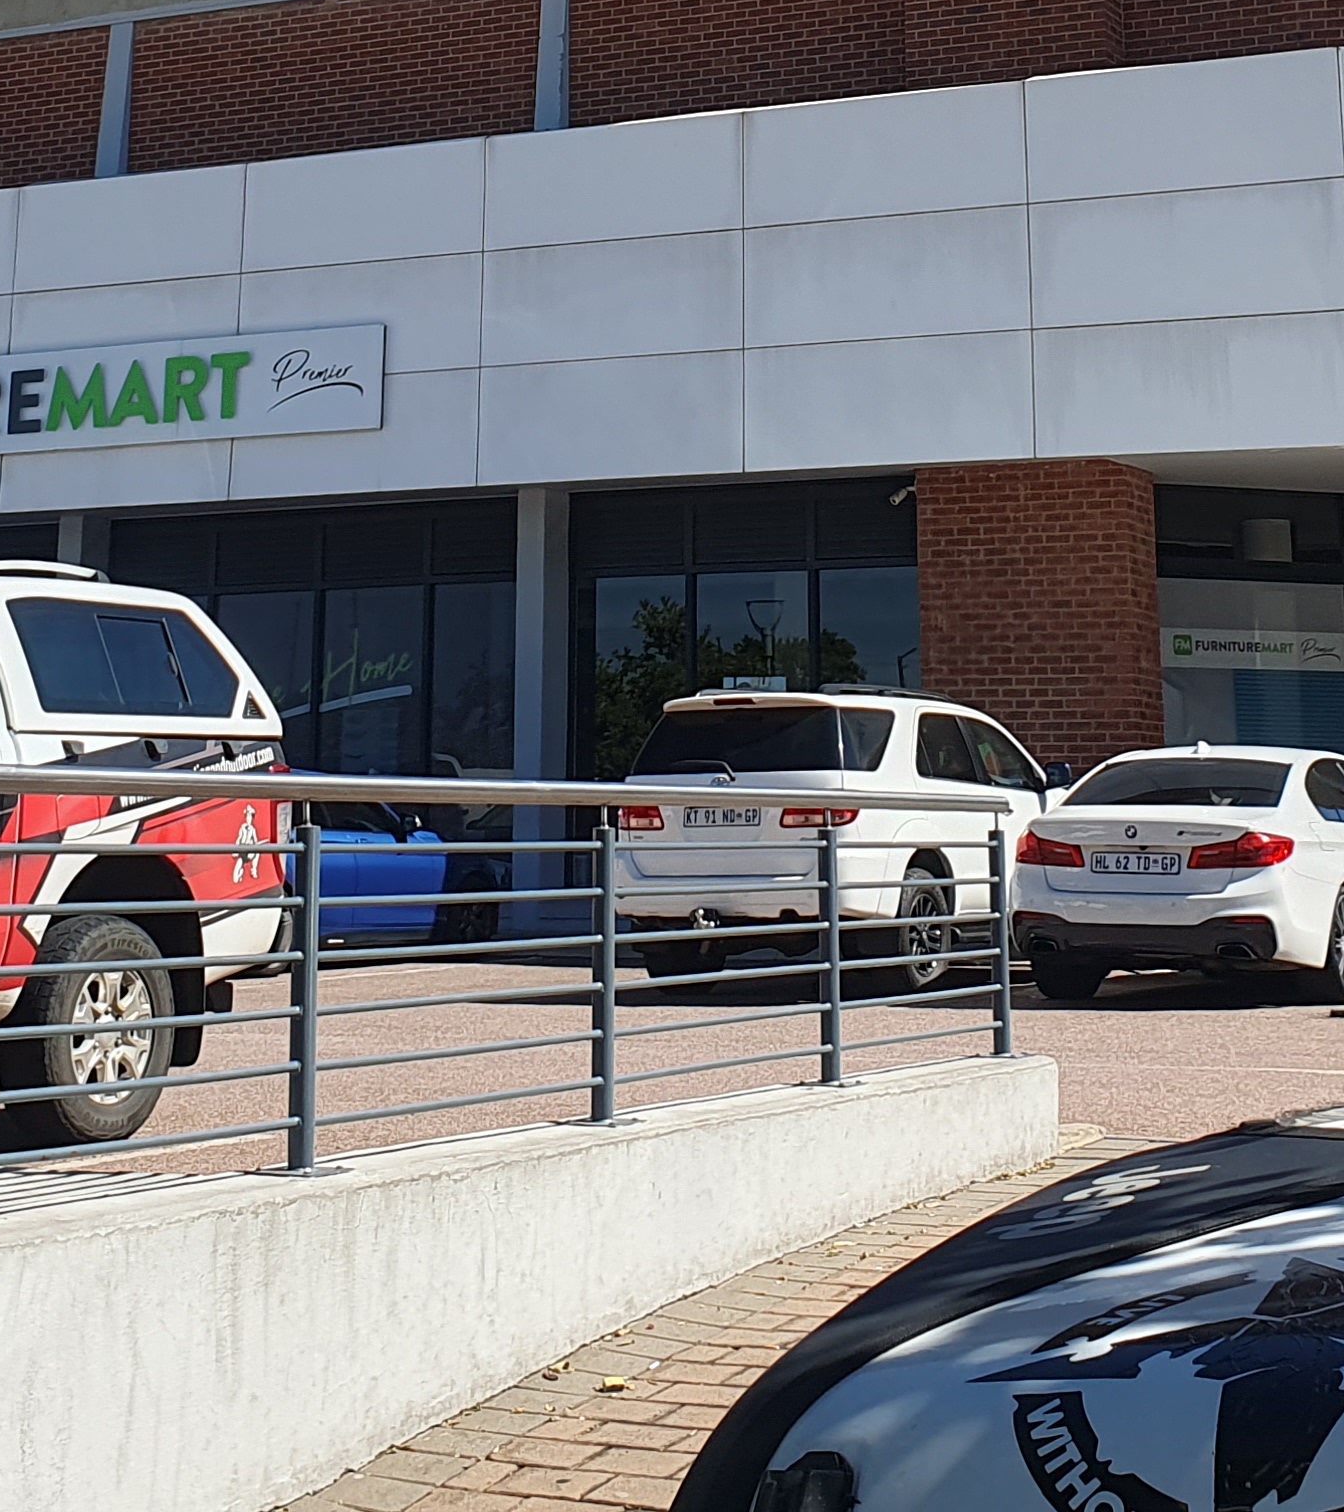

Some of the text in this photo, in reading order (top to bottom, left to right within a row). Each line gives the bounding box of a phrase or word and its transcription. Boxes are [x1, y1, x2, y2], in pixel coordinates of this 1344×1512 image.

[271, 349, 355, 393] Premier
[1194, 639, 1295, 654] FURNITUREMART
[685, 807, 758, 825] KT 91 ND GP
[1095, 854, 1176, 871] HL 62 TD GP
[986, 1164, 1211, 1240] Jeep
[1086, 1294, 1186, 1326] LIVE
[1026, 1398, 1126, 1512] WITHO
